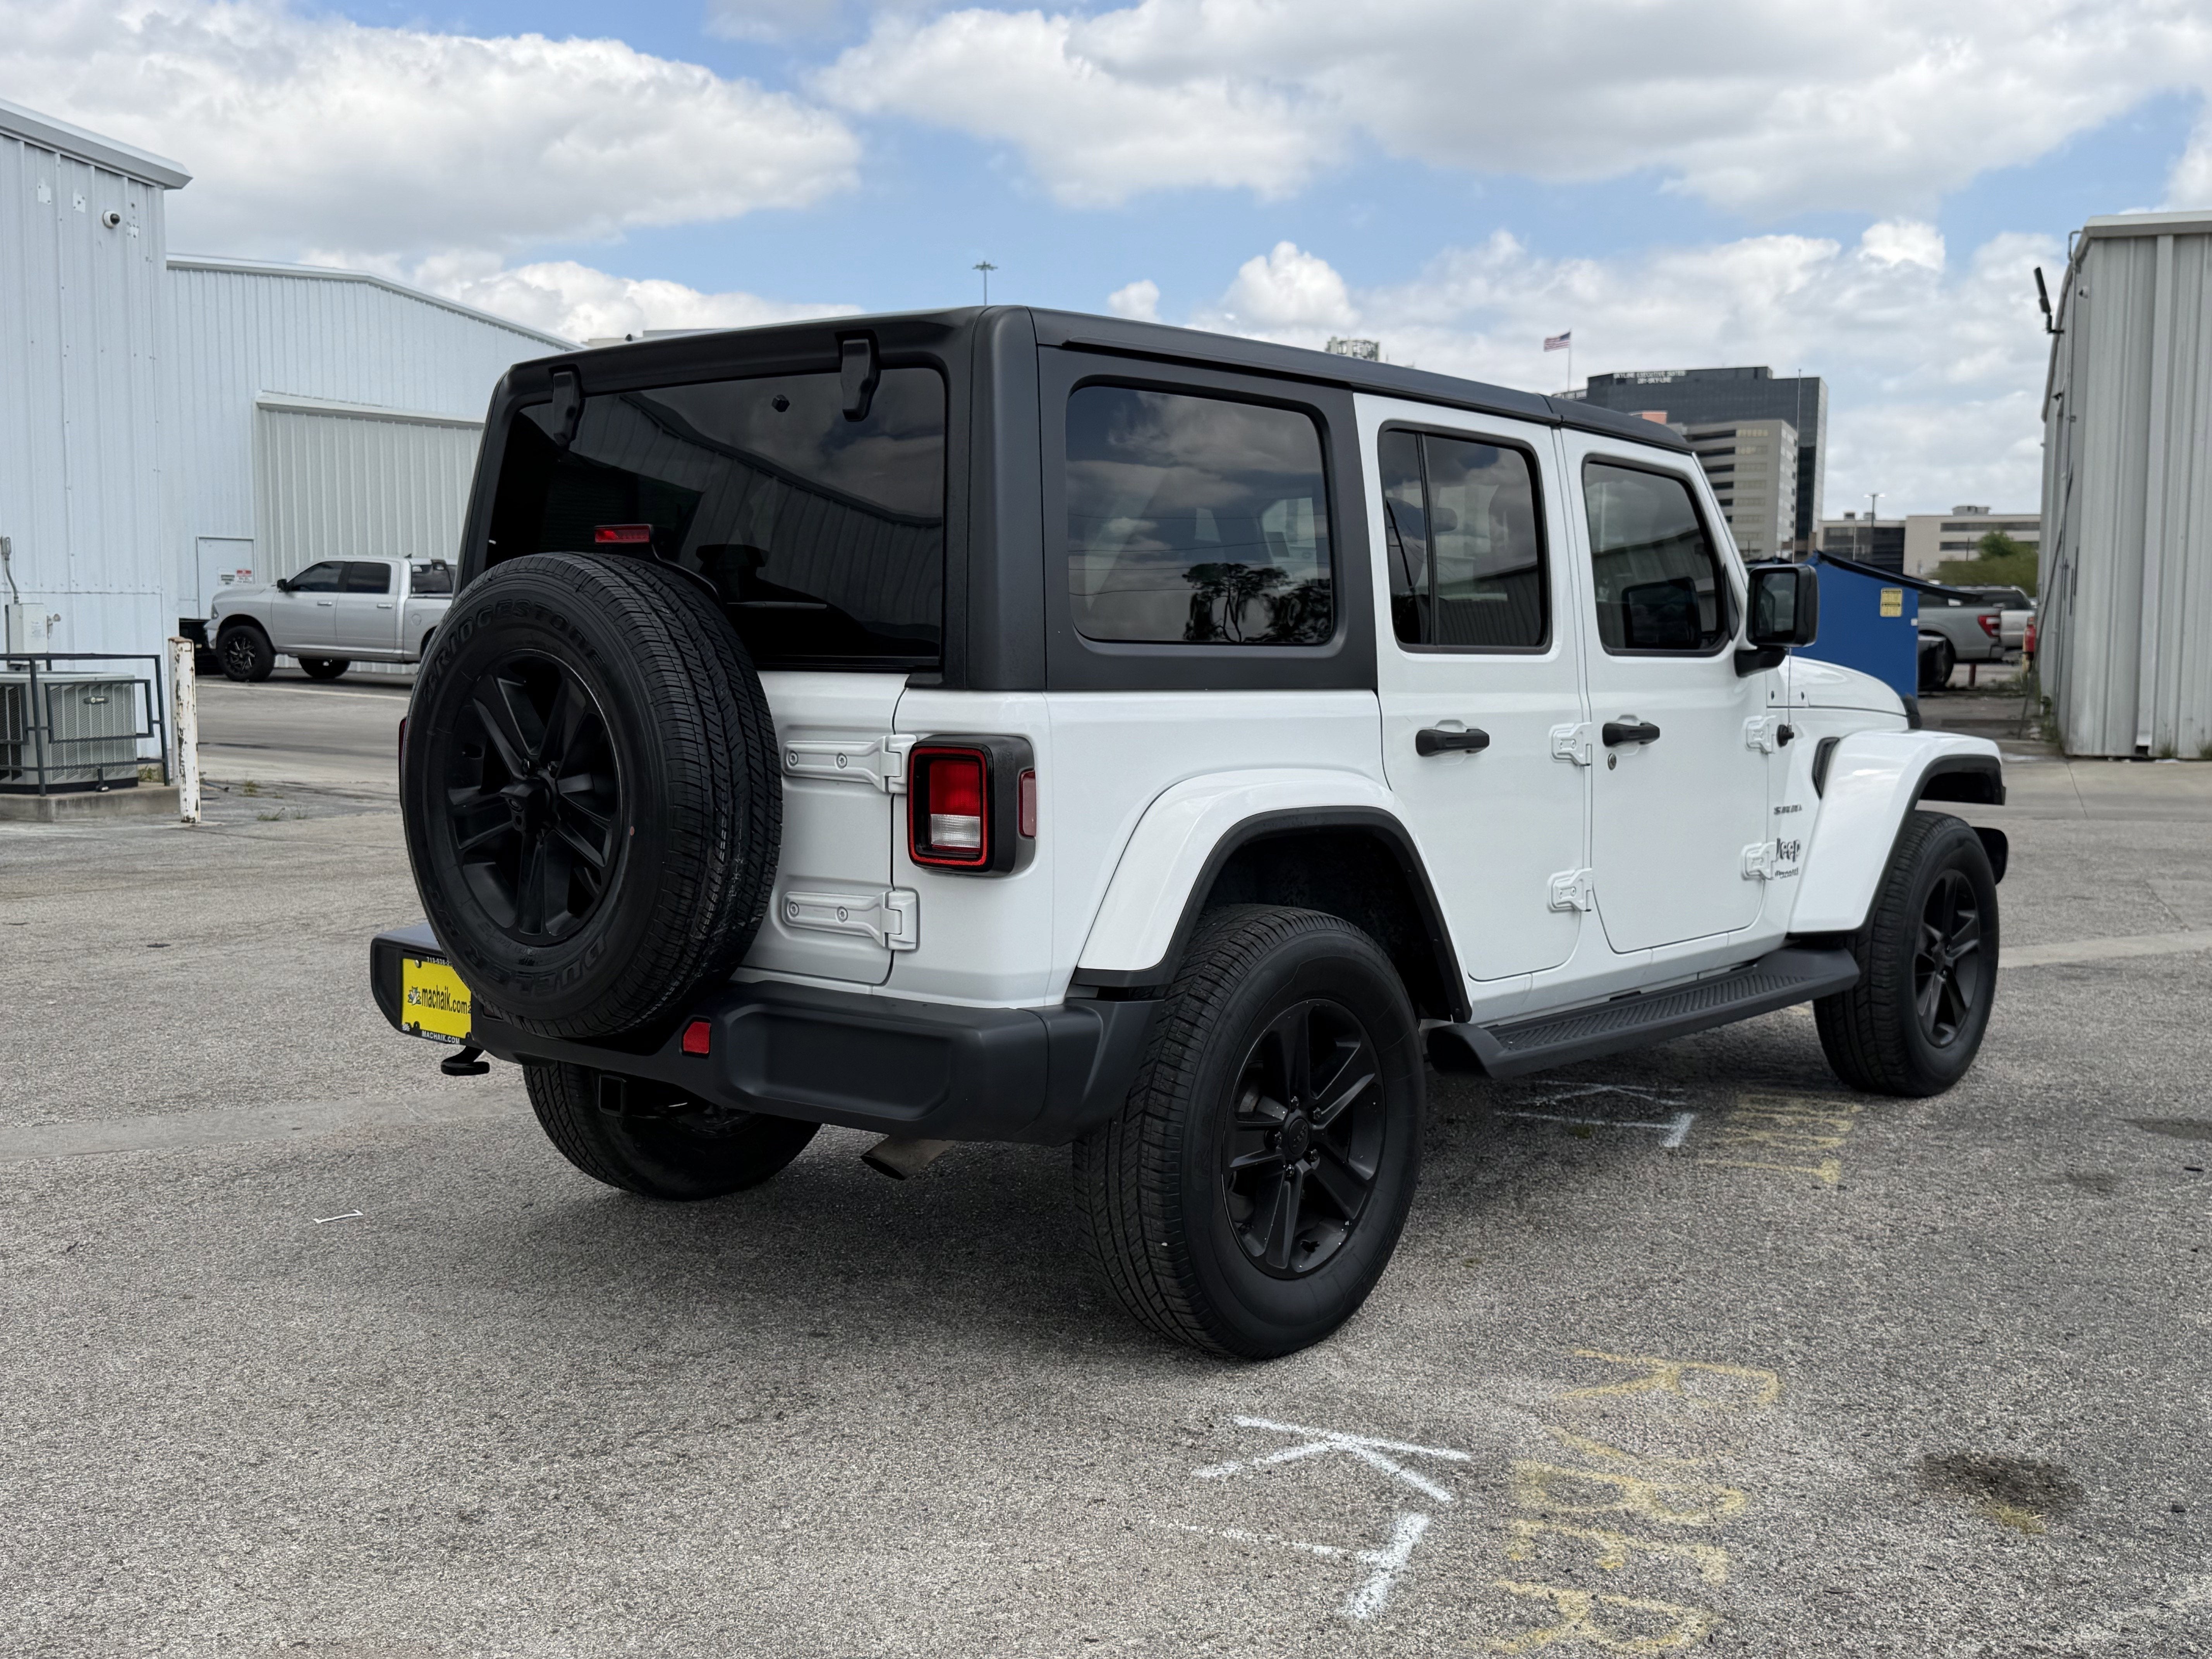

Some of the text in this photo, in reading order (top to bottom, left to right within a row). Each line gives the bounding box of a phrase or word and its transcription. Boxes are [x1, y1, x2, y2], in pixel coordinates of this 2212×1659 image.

[423, 599, 607, 703] BRIDGESTONE
[1776, 838, 1801, 862] Jeep
[464, 933, 606, 997] DUELER
[422, 984, 467, 1015] machaik.com
[422, 1030, 460, 1044] MACHAIK.COM
